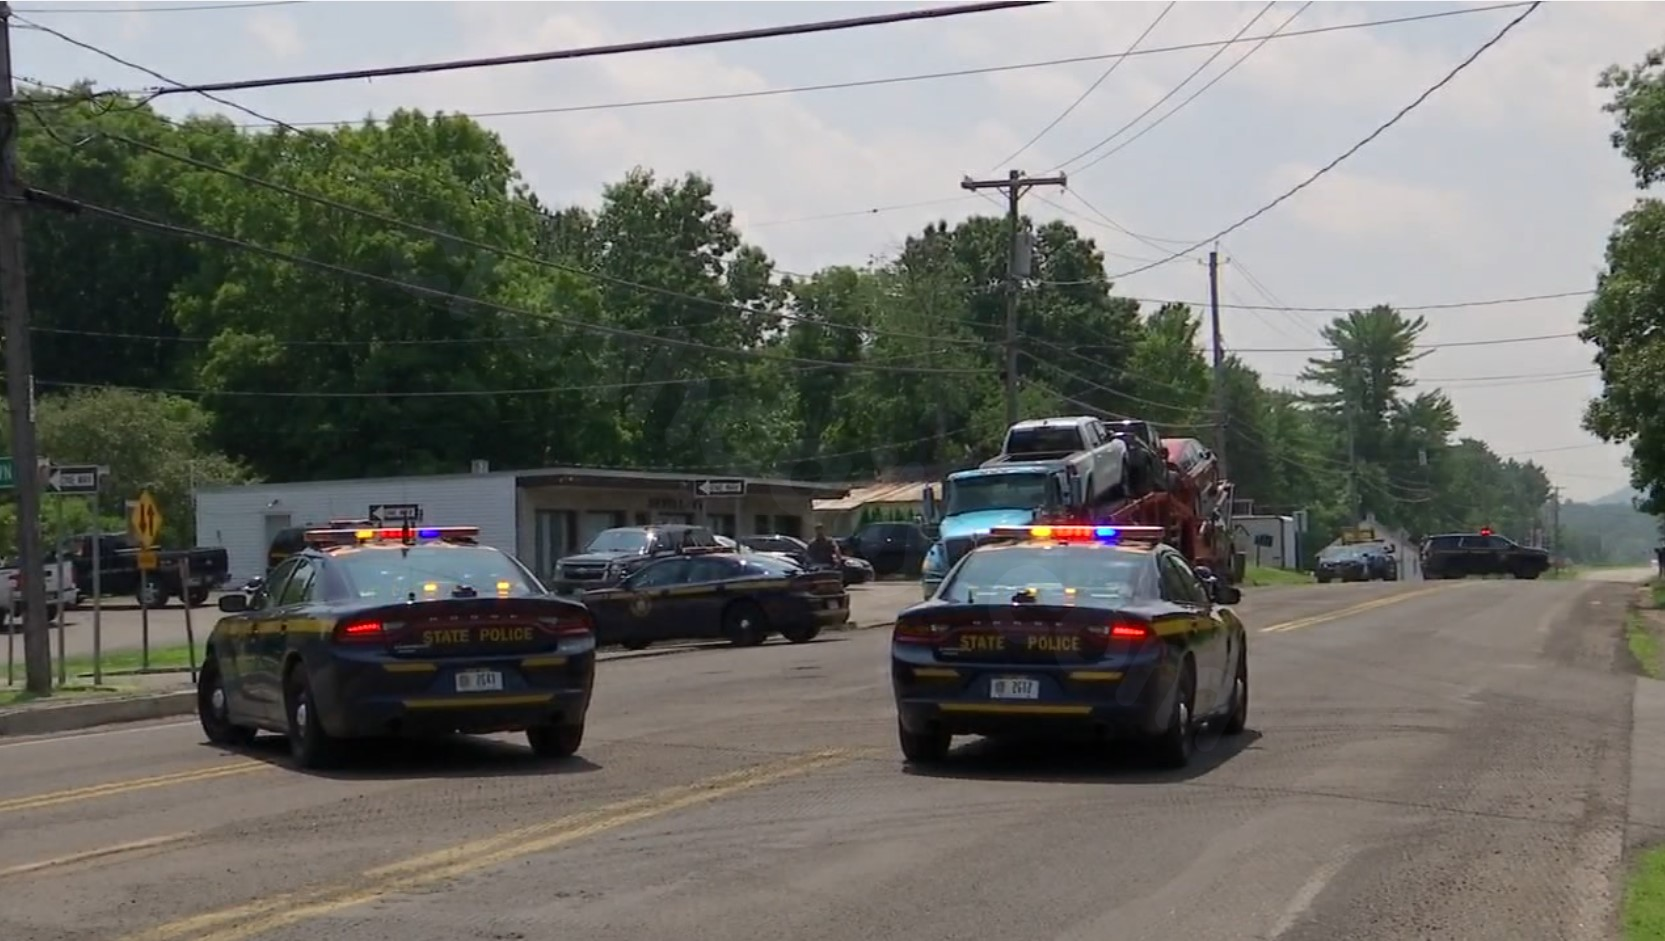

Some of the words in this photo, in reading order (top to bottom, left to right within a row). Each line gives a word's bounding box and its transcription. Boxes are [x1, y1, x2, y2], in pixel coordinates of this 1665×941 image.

[423, 629, 470, 644] STATE
[480, 627, 534, 642] POLICE
[960, 635, 1005, 650] STATE
[1027, 635, 1081, 651] POLICE
